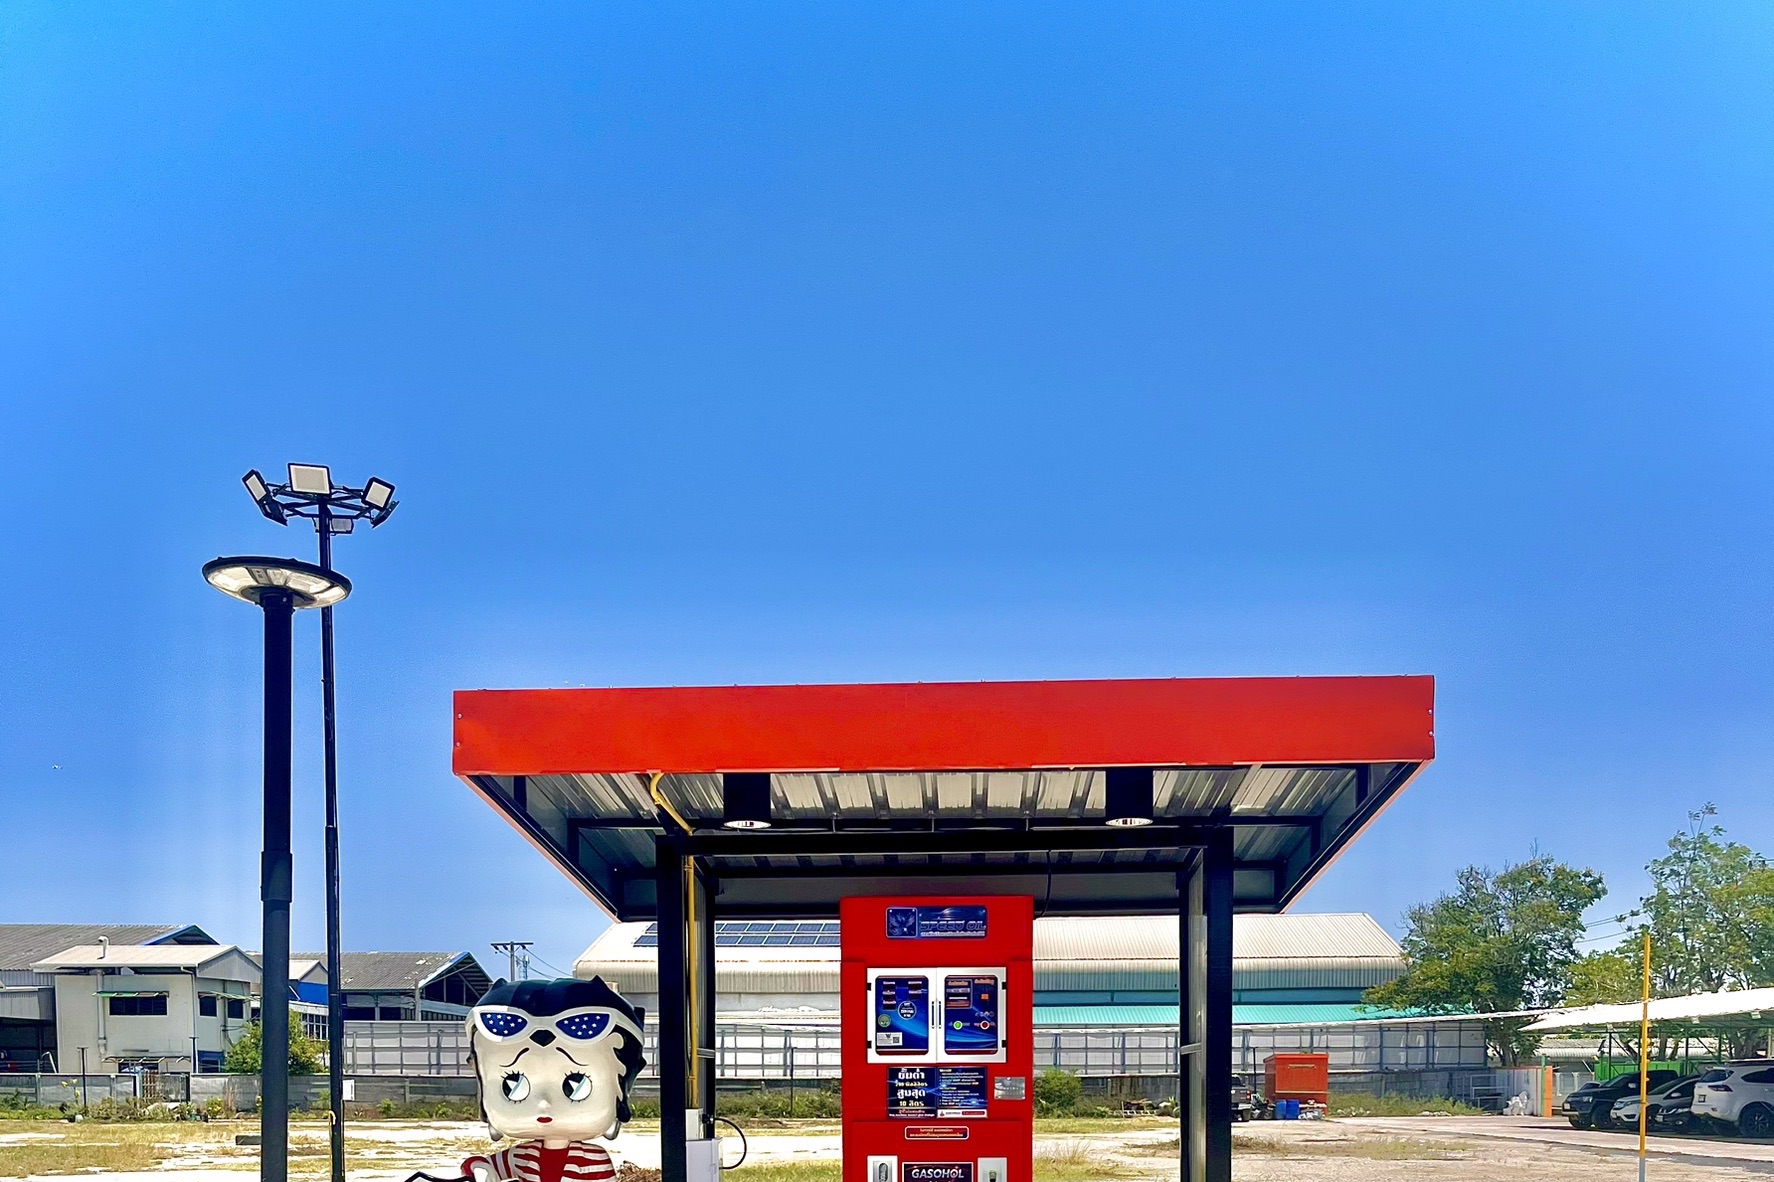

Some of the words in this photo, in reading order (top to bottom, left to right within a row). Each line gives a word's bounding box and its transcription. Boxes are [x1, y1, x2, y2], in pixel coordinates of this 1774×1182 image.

[920, 920, 965, 931] SPEED
[966, 920, 987, 931] OIL
[911, 1168, 964, 1179] GASOHOL
